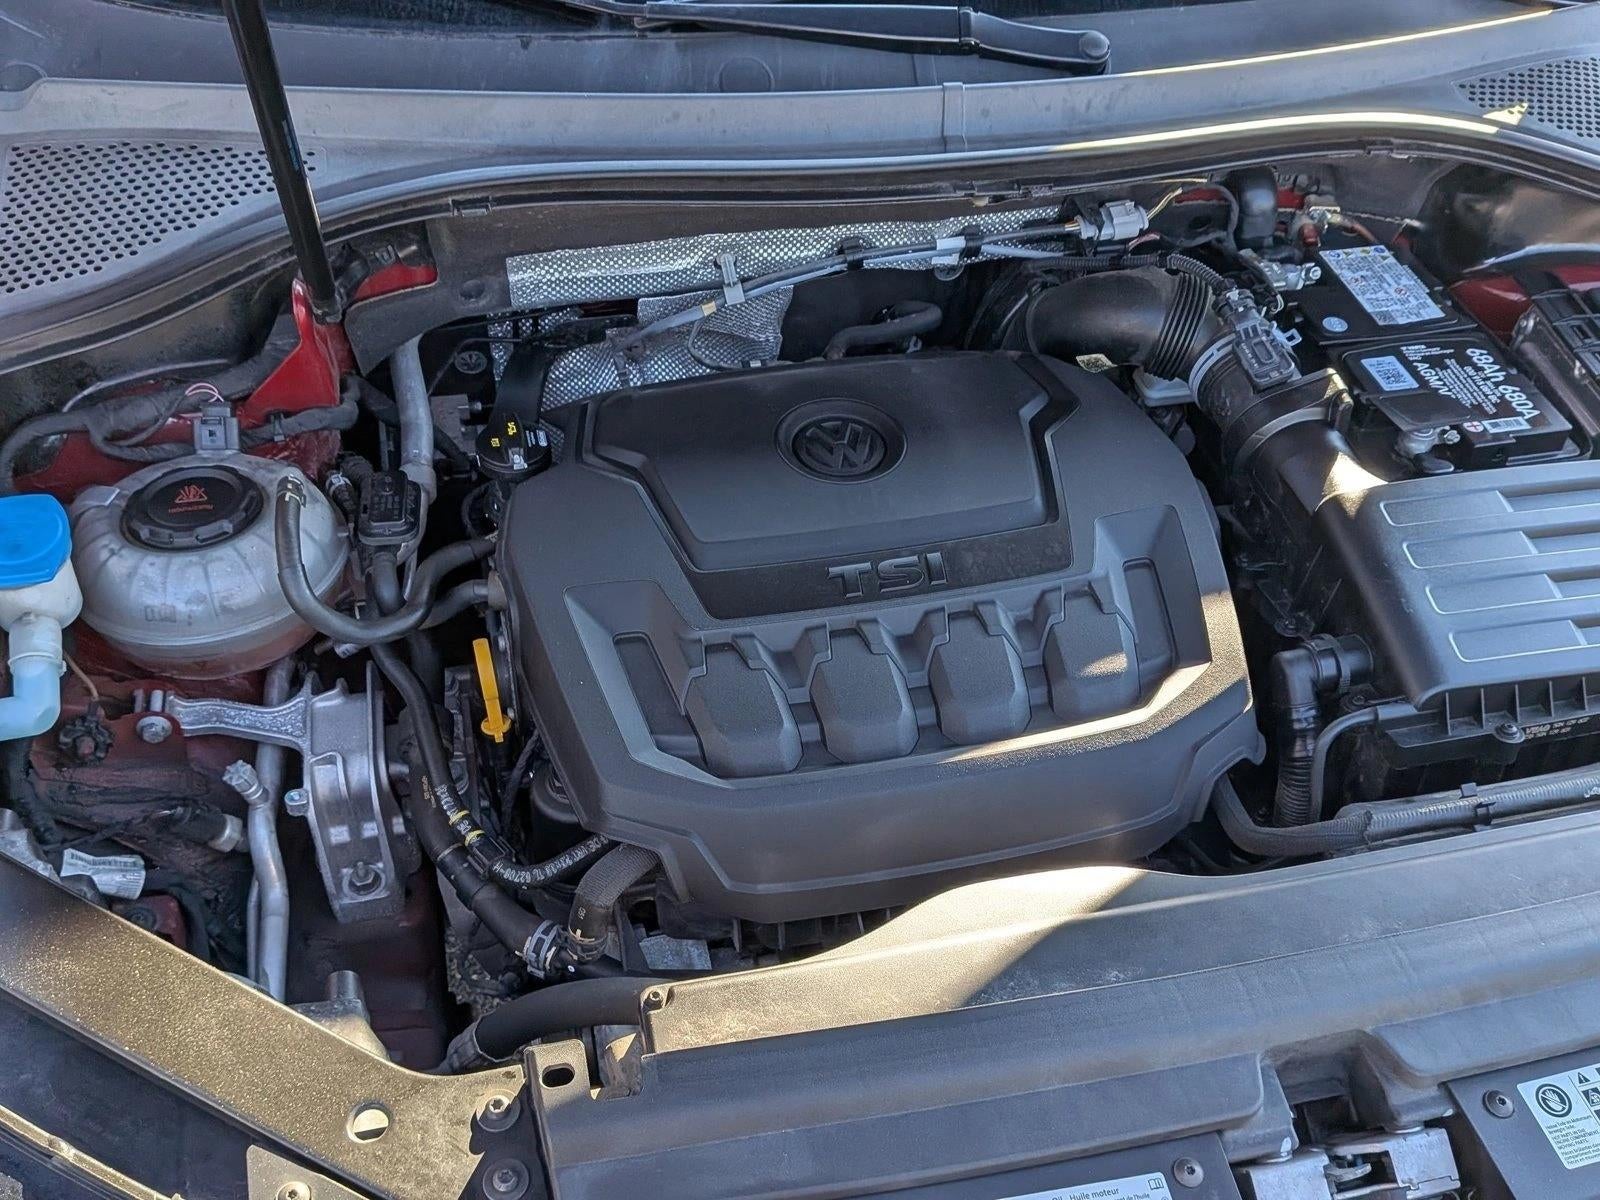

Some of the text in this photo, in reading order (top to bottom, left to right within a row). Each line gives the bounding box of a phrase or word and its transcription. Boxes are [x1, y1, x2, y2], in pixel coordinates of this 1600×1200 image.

[1465, 348, 1507, 381] 68Ah
[1498, 385, 1541, 419] 680A
[825, 552, 948, 599] TSI
[1091, 1187, 1119, 1198] moteur
